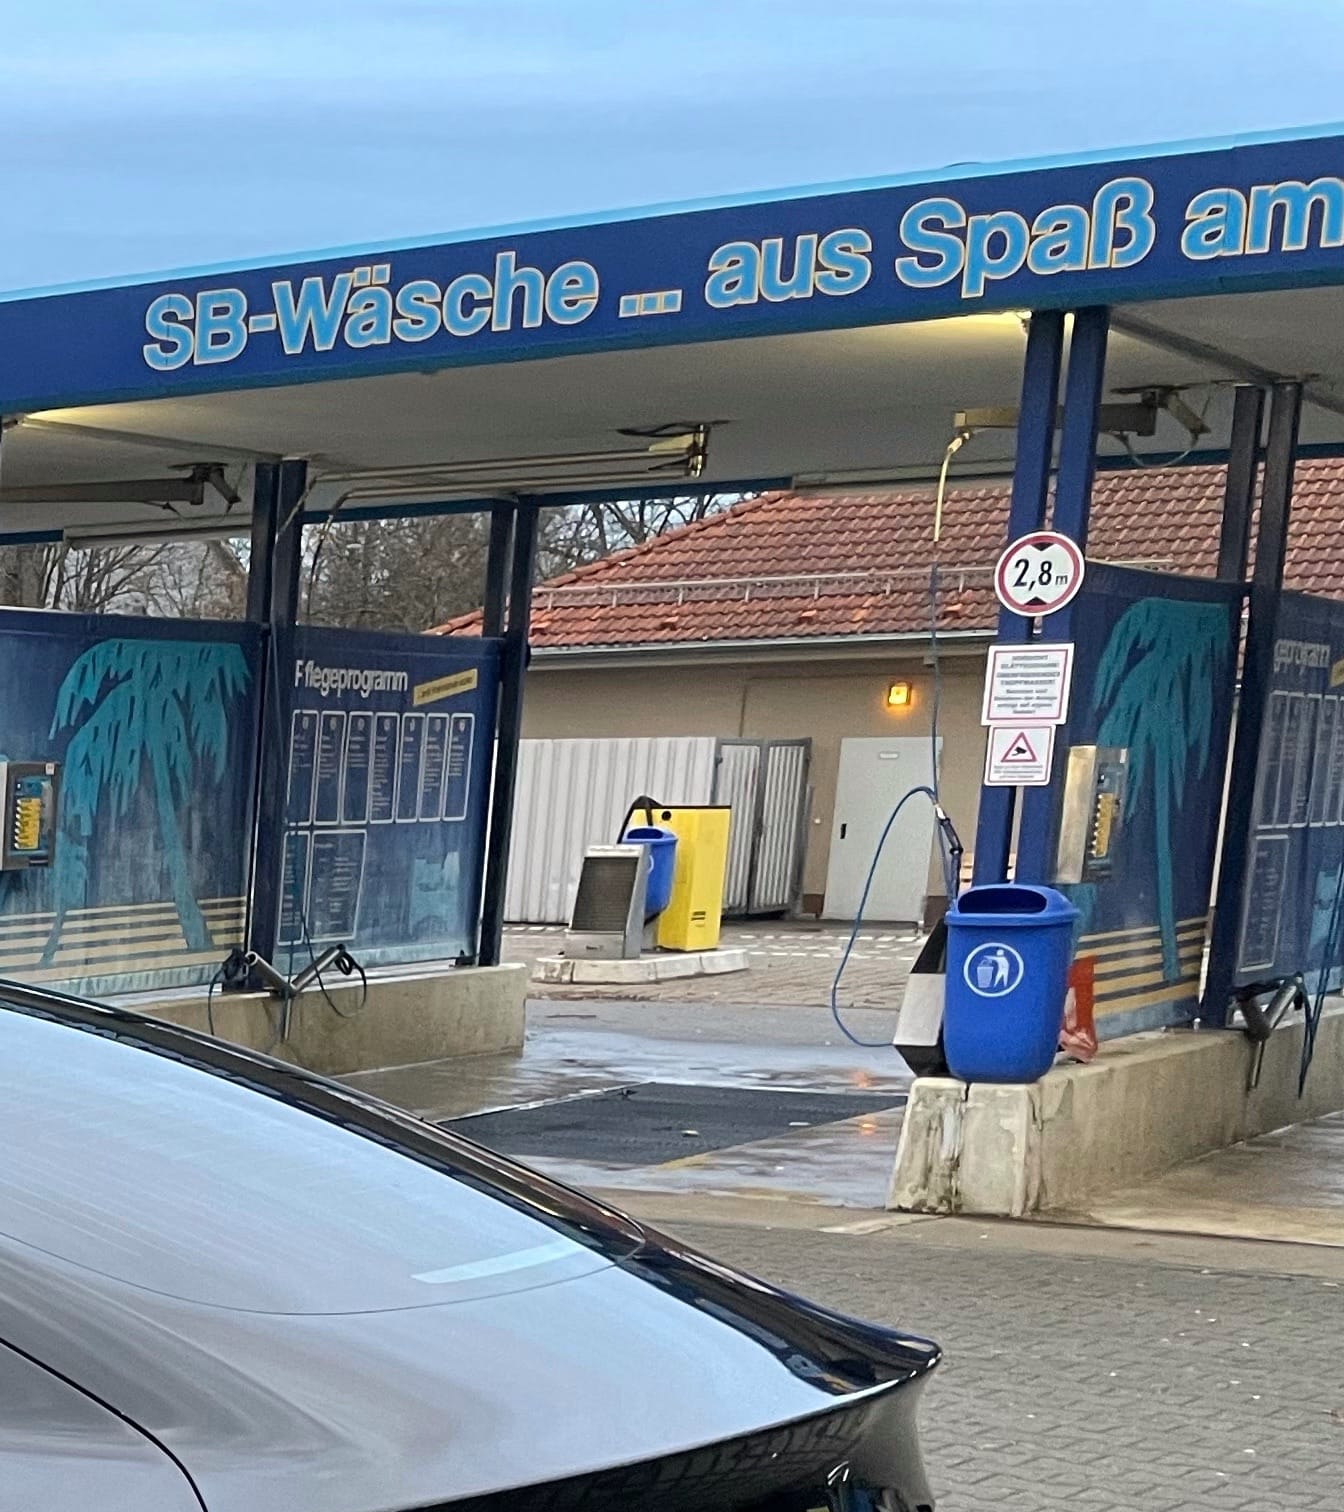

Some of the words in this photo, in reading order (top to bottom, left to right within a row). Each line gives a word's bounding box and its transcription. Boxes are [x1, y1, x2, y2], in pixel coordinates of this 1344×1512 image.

[142, 250, 599, 372] SB-Wäsche
[704, 228, 873, 309] aus
[894, 176, 1157, 300] Spaß
[1180, 175, 1344, 261] am
[1012, 558, 1052, 591] 2,8
[1055, 574, 1068, 586] m
